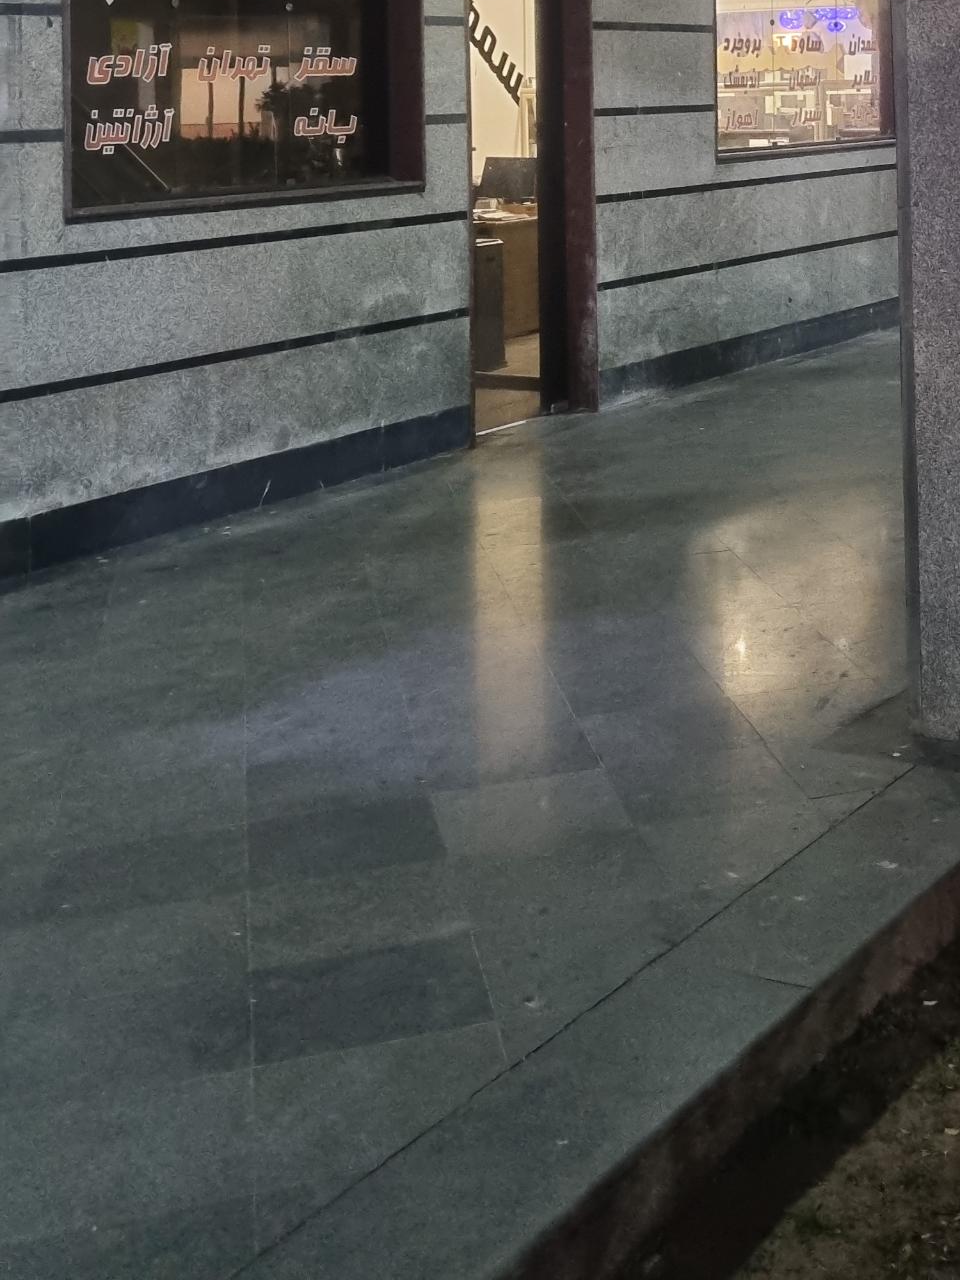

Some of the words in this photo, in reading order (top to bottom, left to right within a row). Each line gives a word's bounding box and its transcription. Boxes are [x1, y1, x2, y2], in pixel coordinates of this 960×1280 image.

[86, 42, 173, 85] آزادی
[198, 44, 272, 84] تهران
[294, 46, 358, 82] سقز
[723, 32, 762, 58] بروجرد
[84, 104, 175, 155] آرژانتین
[293, 106, 358, 144] بانه
